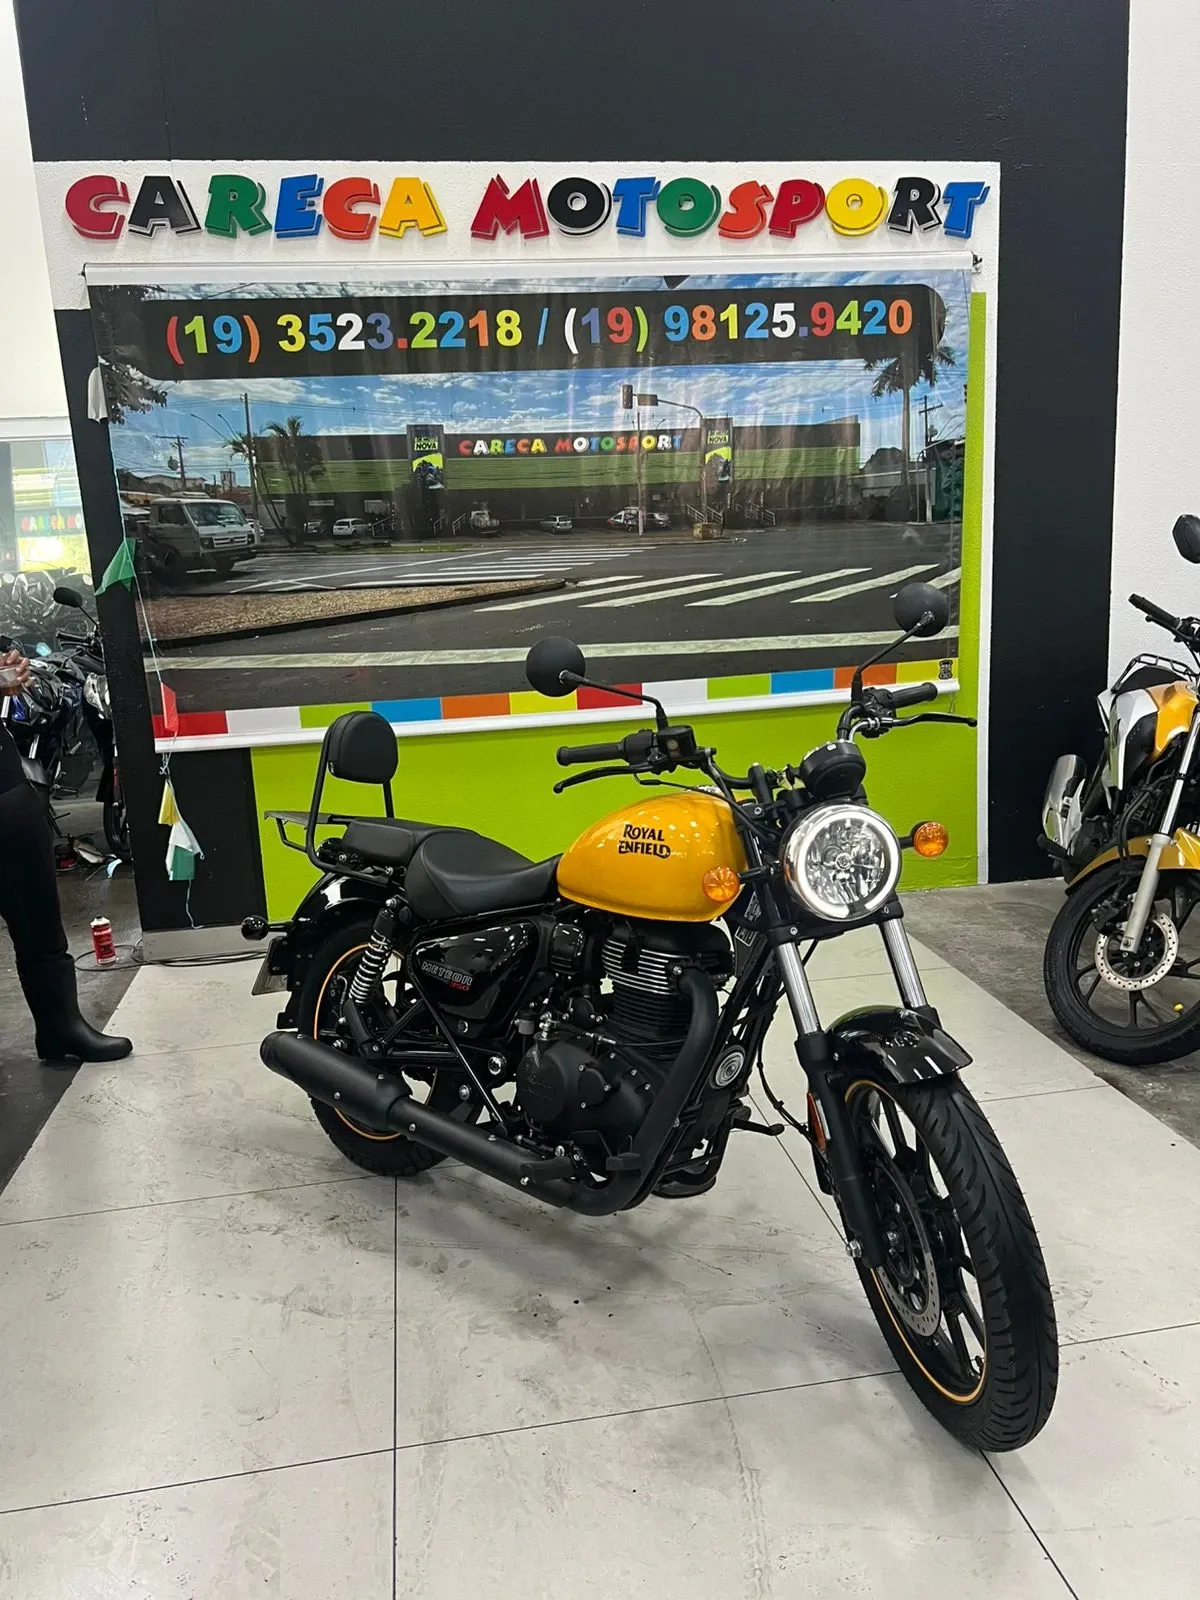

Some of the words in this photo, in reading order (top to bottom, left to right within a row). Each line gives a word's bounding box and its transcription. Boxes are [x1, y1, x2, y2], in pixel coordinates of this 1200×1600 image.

[65, 174, 447, 239] CARECA
[471, 174, 990, 239] MOTOSPORT
[166, 314, 261, 365] (19)
[277, 309, 523, 353] 3523.2218
[564, 306, 648, 354] (19)
[665, 299, 913, 342] 98125.9420
[457, 438, 548, 456] CARECA
[554, 434, 683, 454] MOTOSPORT
[623, 824, 665, 841] ROYAL
[618, 840, 671, 859] ENFIELD
[421, 961, 472, 986] METEOR
